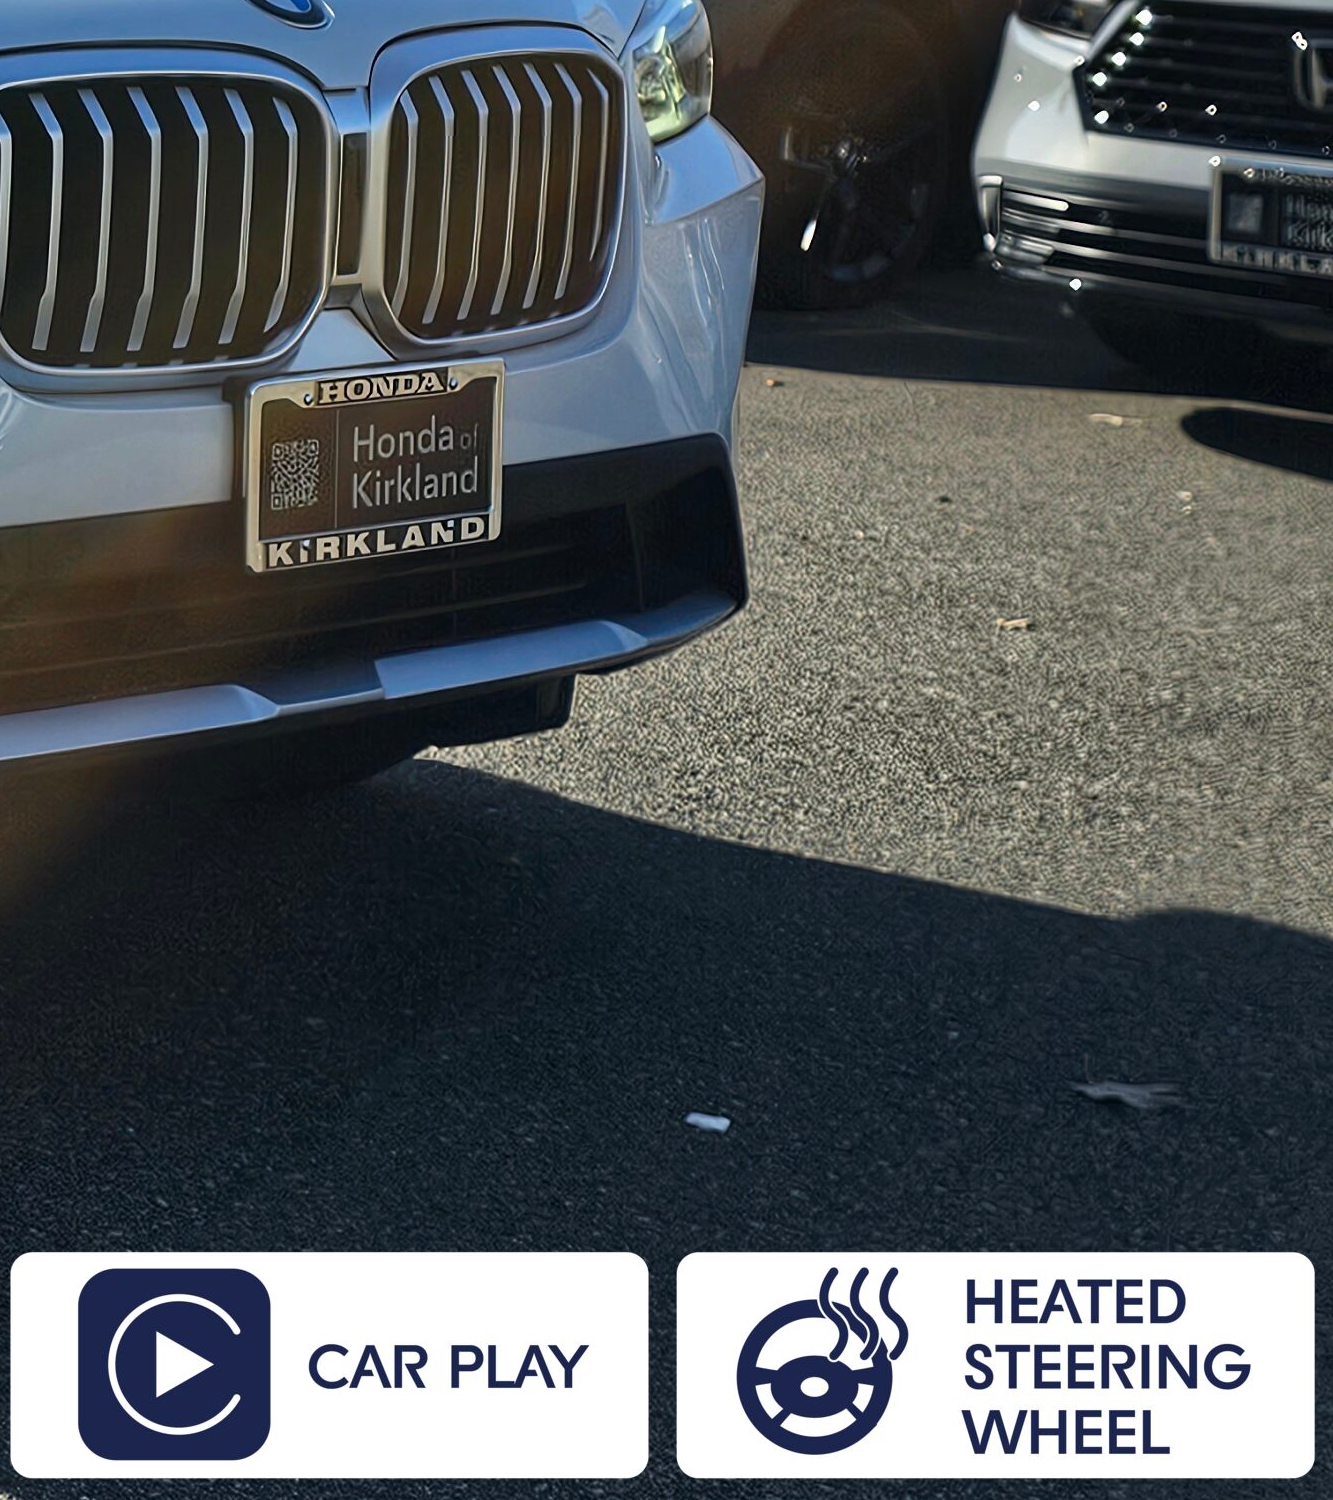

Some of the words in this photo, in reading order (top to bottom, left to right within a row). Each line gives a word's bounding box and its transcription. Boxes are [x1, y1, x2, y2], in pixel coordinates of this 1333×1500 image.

[319, 372, 445, 404] HONDA
[353, 415, 454, 462] Honda
[460, 422, 479, 450] of
[352, 456, 479, 509] Kirkland
[268, 517, 486, 568] KIRKLAND
